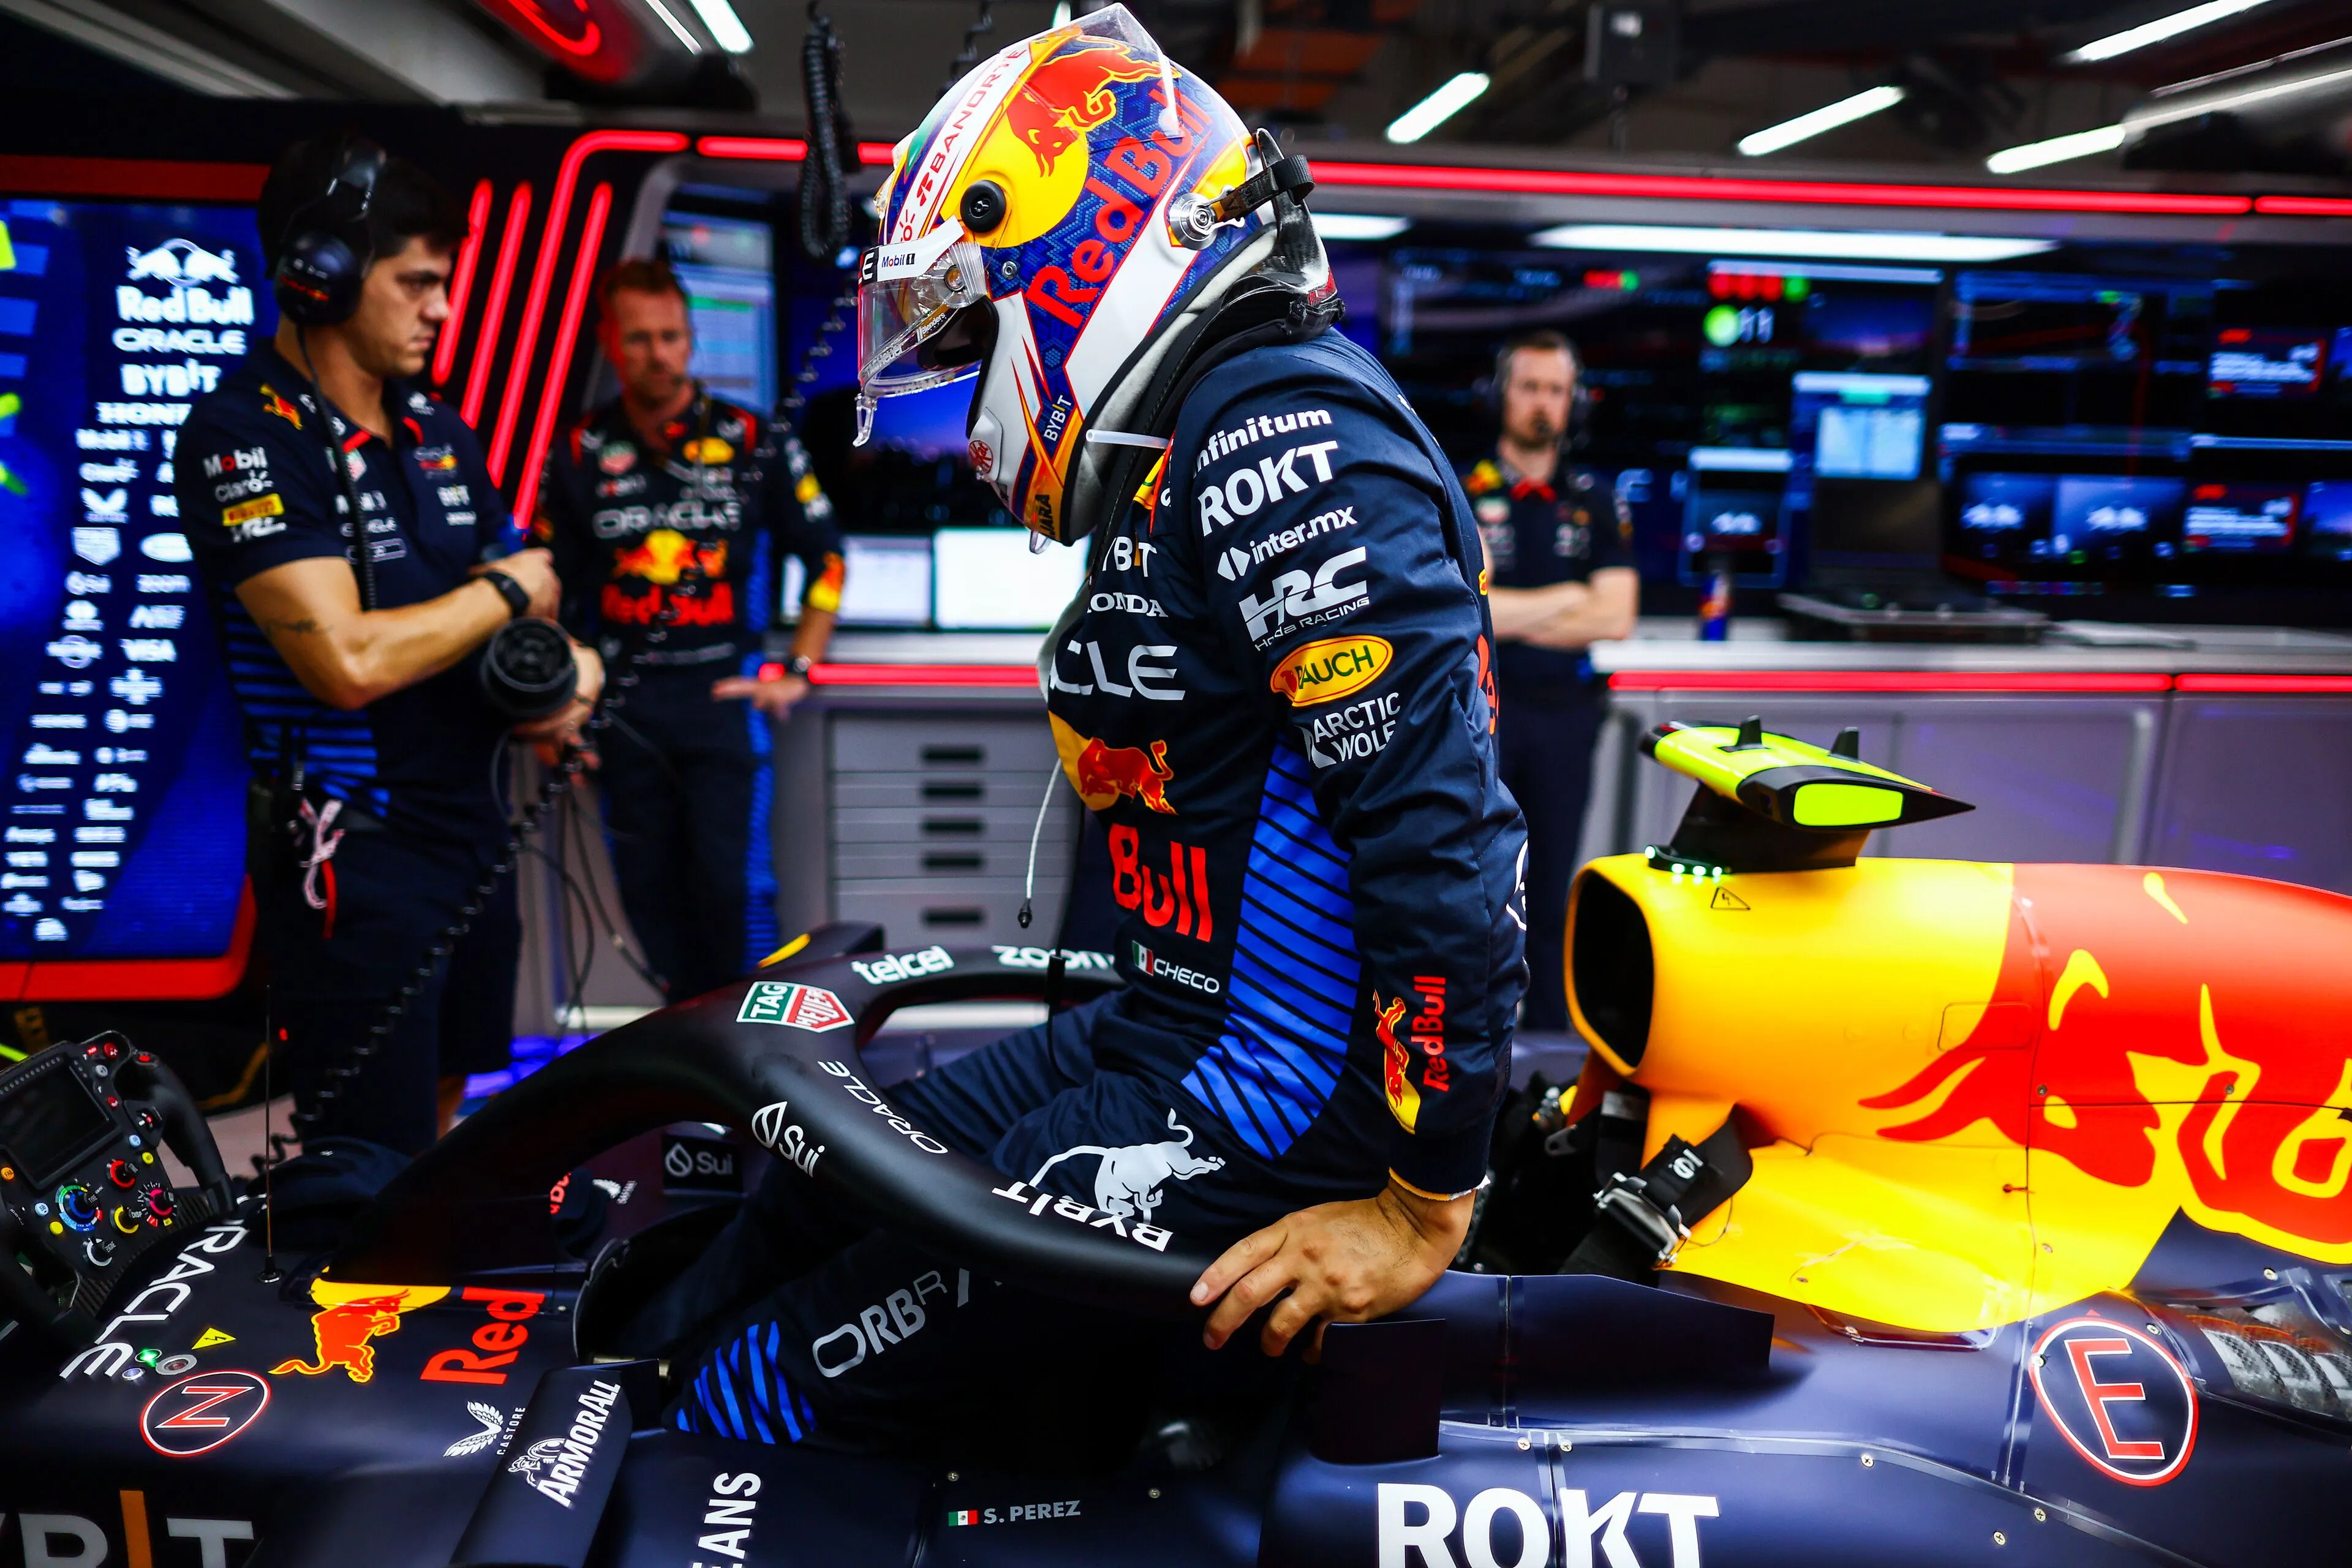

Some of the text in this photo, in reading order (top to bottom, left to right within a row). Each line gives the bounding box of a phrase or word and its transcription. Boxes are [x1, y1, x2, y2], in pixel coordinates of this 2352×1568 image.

[1025, 80, 1212, 328] Red Bull
[881, 254, 905, 268] Mobil
[906, 253, 915, 265] 1
[111, 327, 247, 355] ORACLE
[921, 312, 946, 334] Blenders
[120, 357, 222, 396] BYBIT
[96, 401, 192, 426] HON
[1044, 395, 1071, 441] BYBIT
[203, 447, 268, 478] Mobil
[1197, 440, 1338, 537] ROKT
[593, 500, 742, 539] ORACLE
[1250, 506, 1357, 564] inter.mx
[1102, 532, 1157, 578] BIT
[1087, 592, 1169, 618] ONDA
[1238, 546, 1367, 642] HRC
[1298, 596, 1370, 628] RACING
[1313, 692, 1401, 743] ARCTIC
[1331, 720, 1396, 762] WOLF
[1108, 822, 1213, 943] Bull
[851, 945, 955, 985] telcel
[1153, 958, 1220, 993] CHECO
[750, 984, 788, 1018] TAG
[795, 987, 841, 1027] HEUER
[1411, 975, 1450, 1093] Red Bull
[817, 1060, 949, 1155] ORACLE
[696, 1151, 733, 1175] Sui
[778, 1125, 825, 1178] Sui
[991, 1181, 1174, 1252] BYBIT
[420, 1286, 546, 1385] Red
[2064, 1338, 2166, 1460] E
[496, 1406, 526, 1455] CASTORE
[0, 1490, 254, 1568] BIT
[692, 1472, 761, 1568] ANS
[983, 1499, 1081, 1524] S. PEREZ
[1378, 1482, 1721, 1568] ROKT
